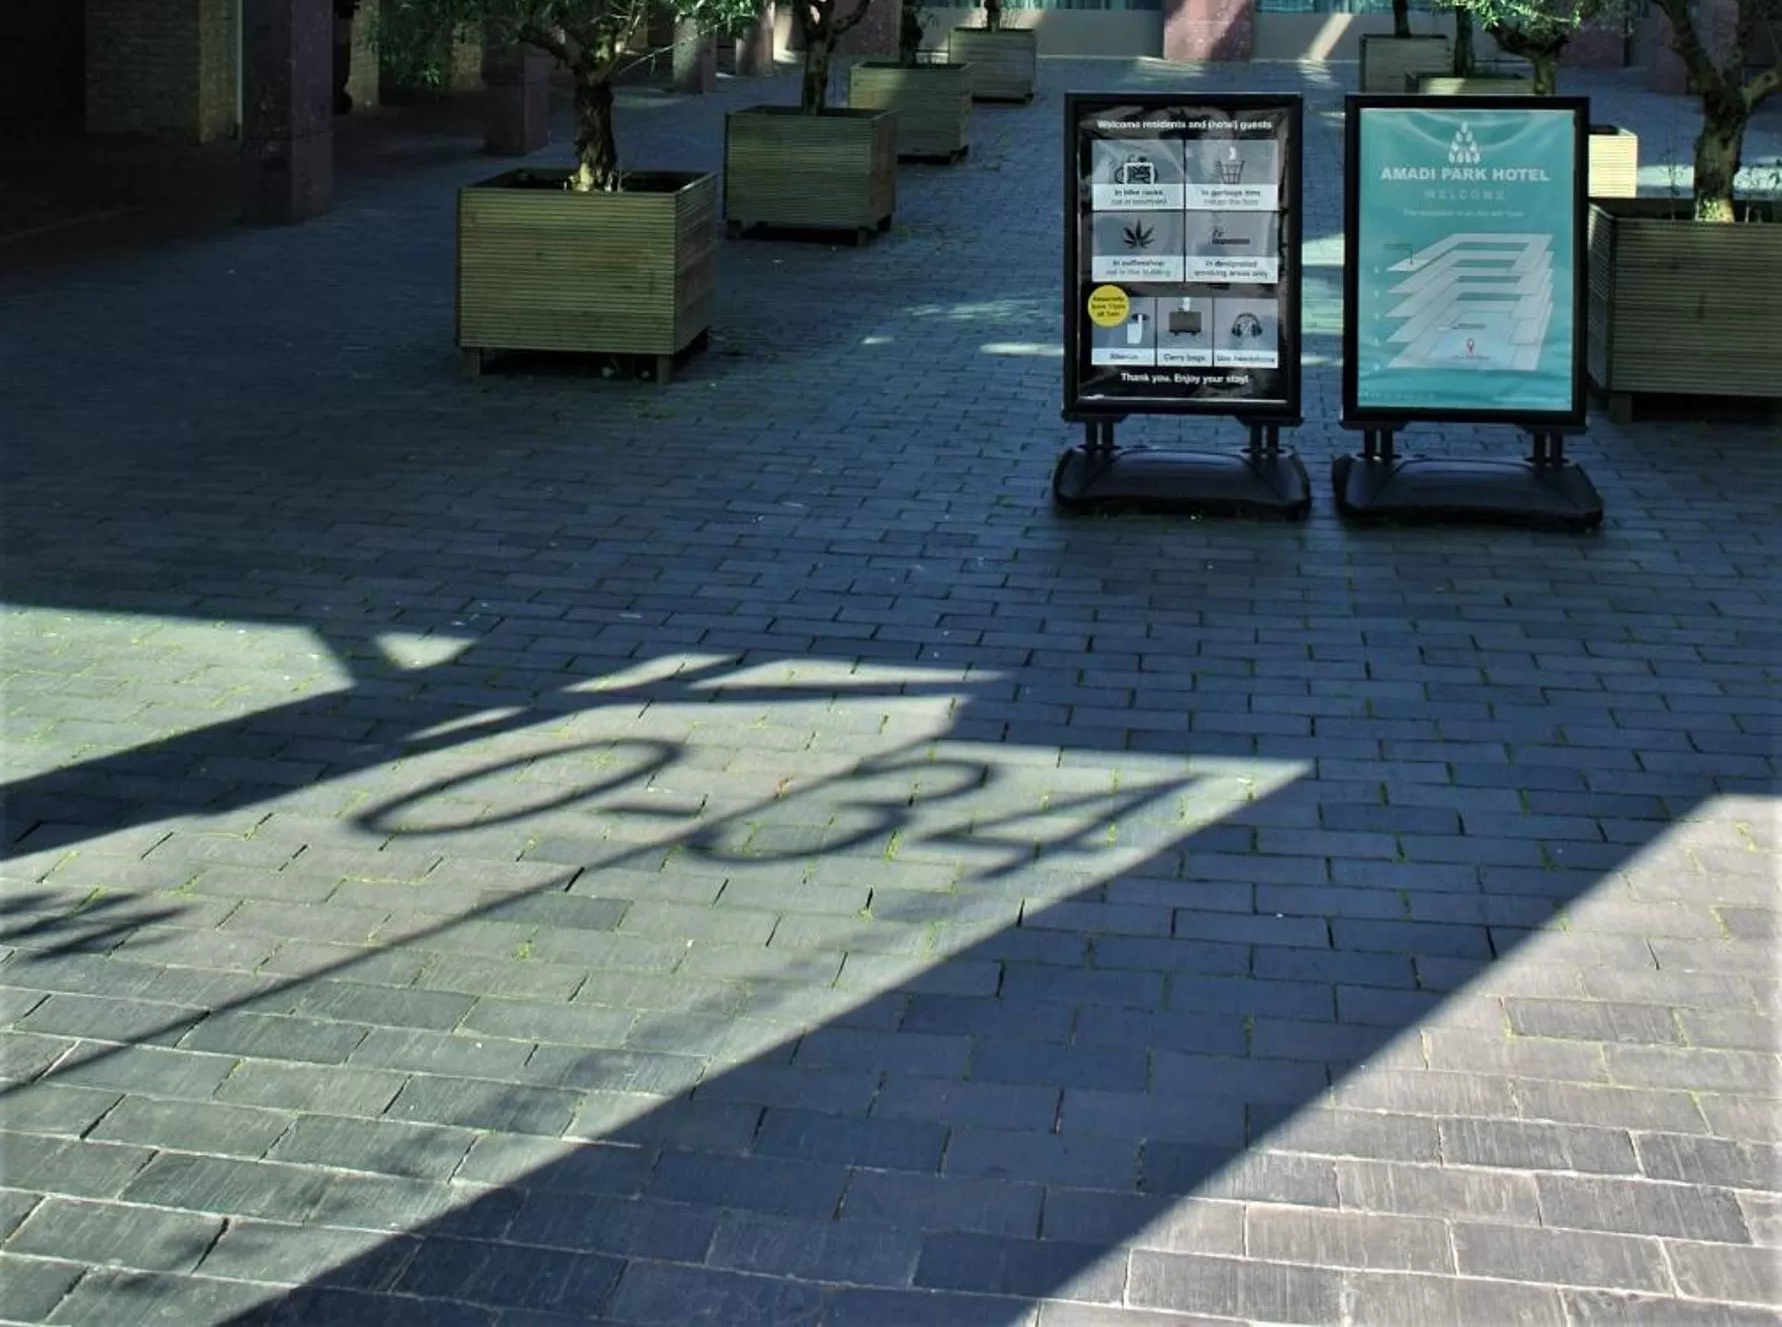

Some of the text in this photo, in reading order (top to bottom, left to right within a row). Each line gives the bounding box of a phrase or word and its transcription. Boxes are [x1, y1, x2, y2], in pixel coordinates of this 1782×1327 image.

[1097, 120, 1141, 130] Welcome
[1143, 120, 1187, 130] residents
[1189, 120, 1207, 130] and
[1240, 121, 1273, 132] guests
[1381, 167, 1550, 182] AMADI PARK HOTEL
[1423, 189, 1505, 200] WELCOME
[1120, 373, 1150, 382] Thank
[1174, 373, 1201, 384] Enjoy
[1202, 374, 1224, 384] your
[1226, 374, 1249, 384] stay!
